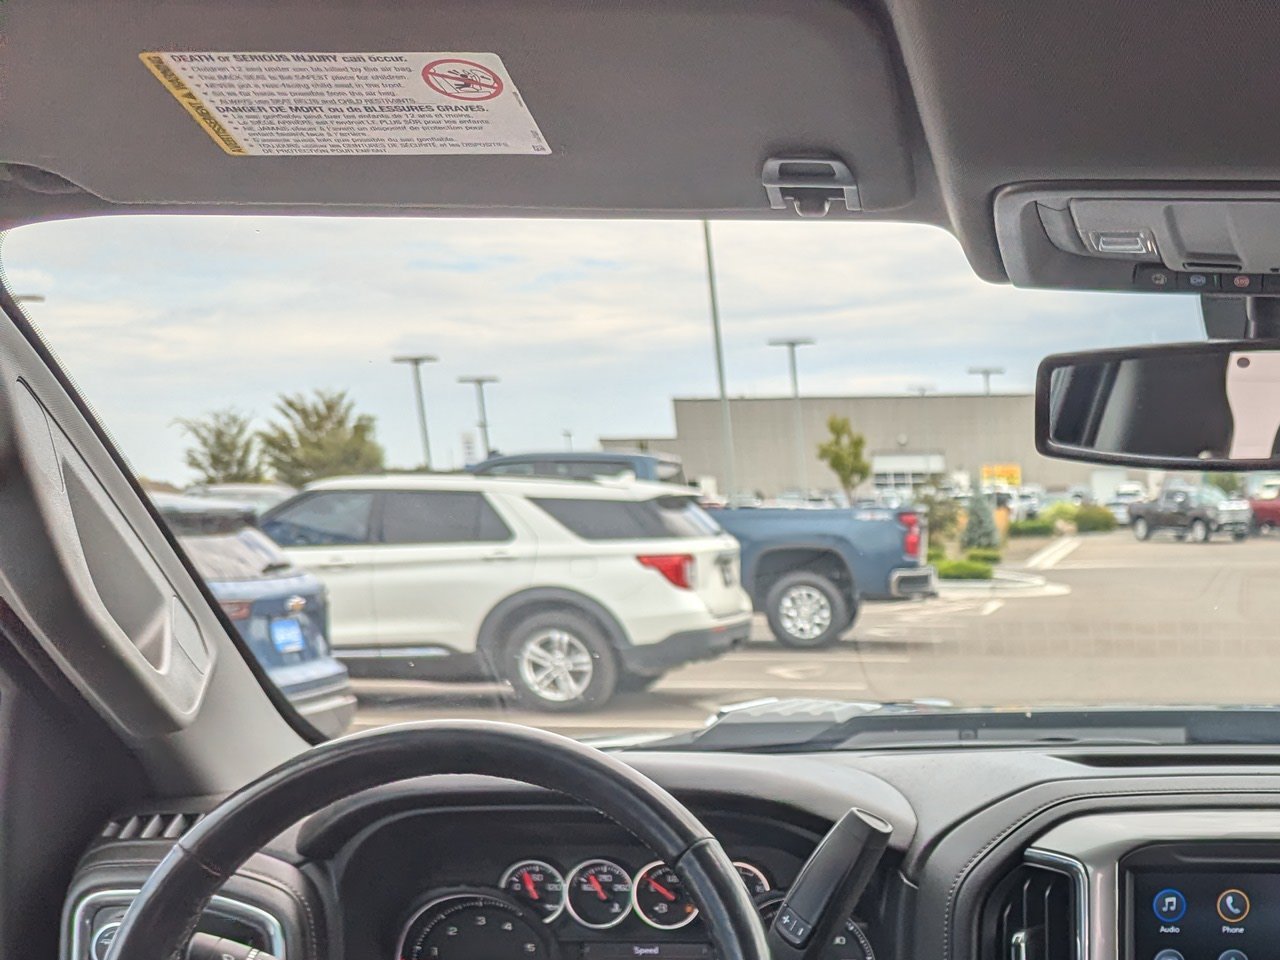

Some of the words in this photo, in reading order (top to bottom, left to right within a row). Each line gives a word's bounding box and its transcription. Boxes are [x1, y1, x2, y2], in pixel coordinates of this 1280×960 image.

[170, 54, 215, 62] DEATH
[232, 54, 291, 62] SERIOUS
[291, 54, 338, 62] INJURY
[476, 916, 486, 926] 3
[448, 926, 458, 935] 2
[503, 922, 512, 930] 4
[1222, 926, 1244, 934] Phone
[526, 943, 536, 952] 5
[633, 946, 660, 956] Speed
